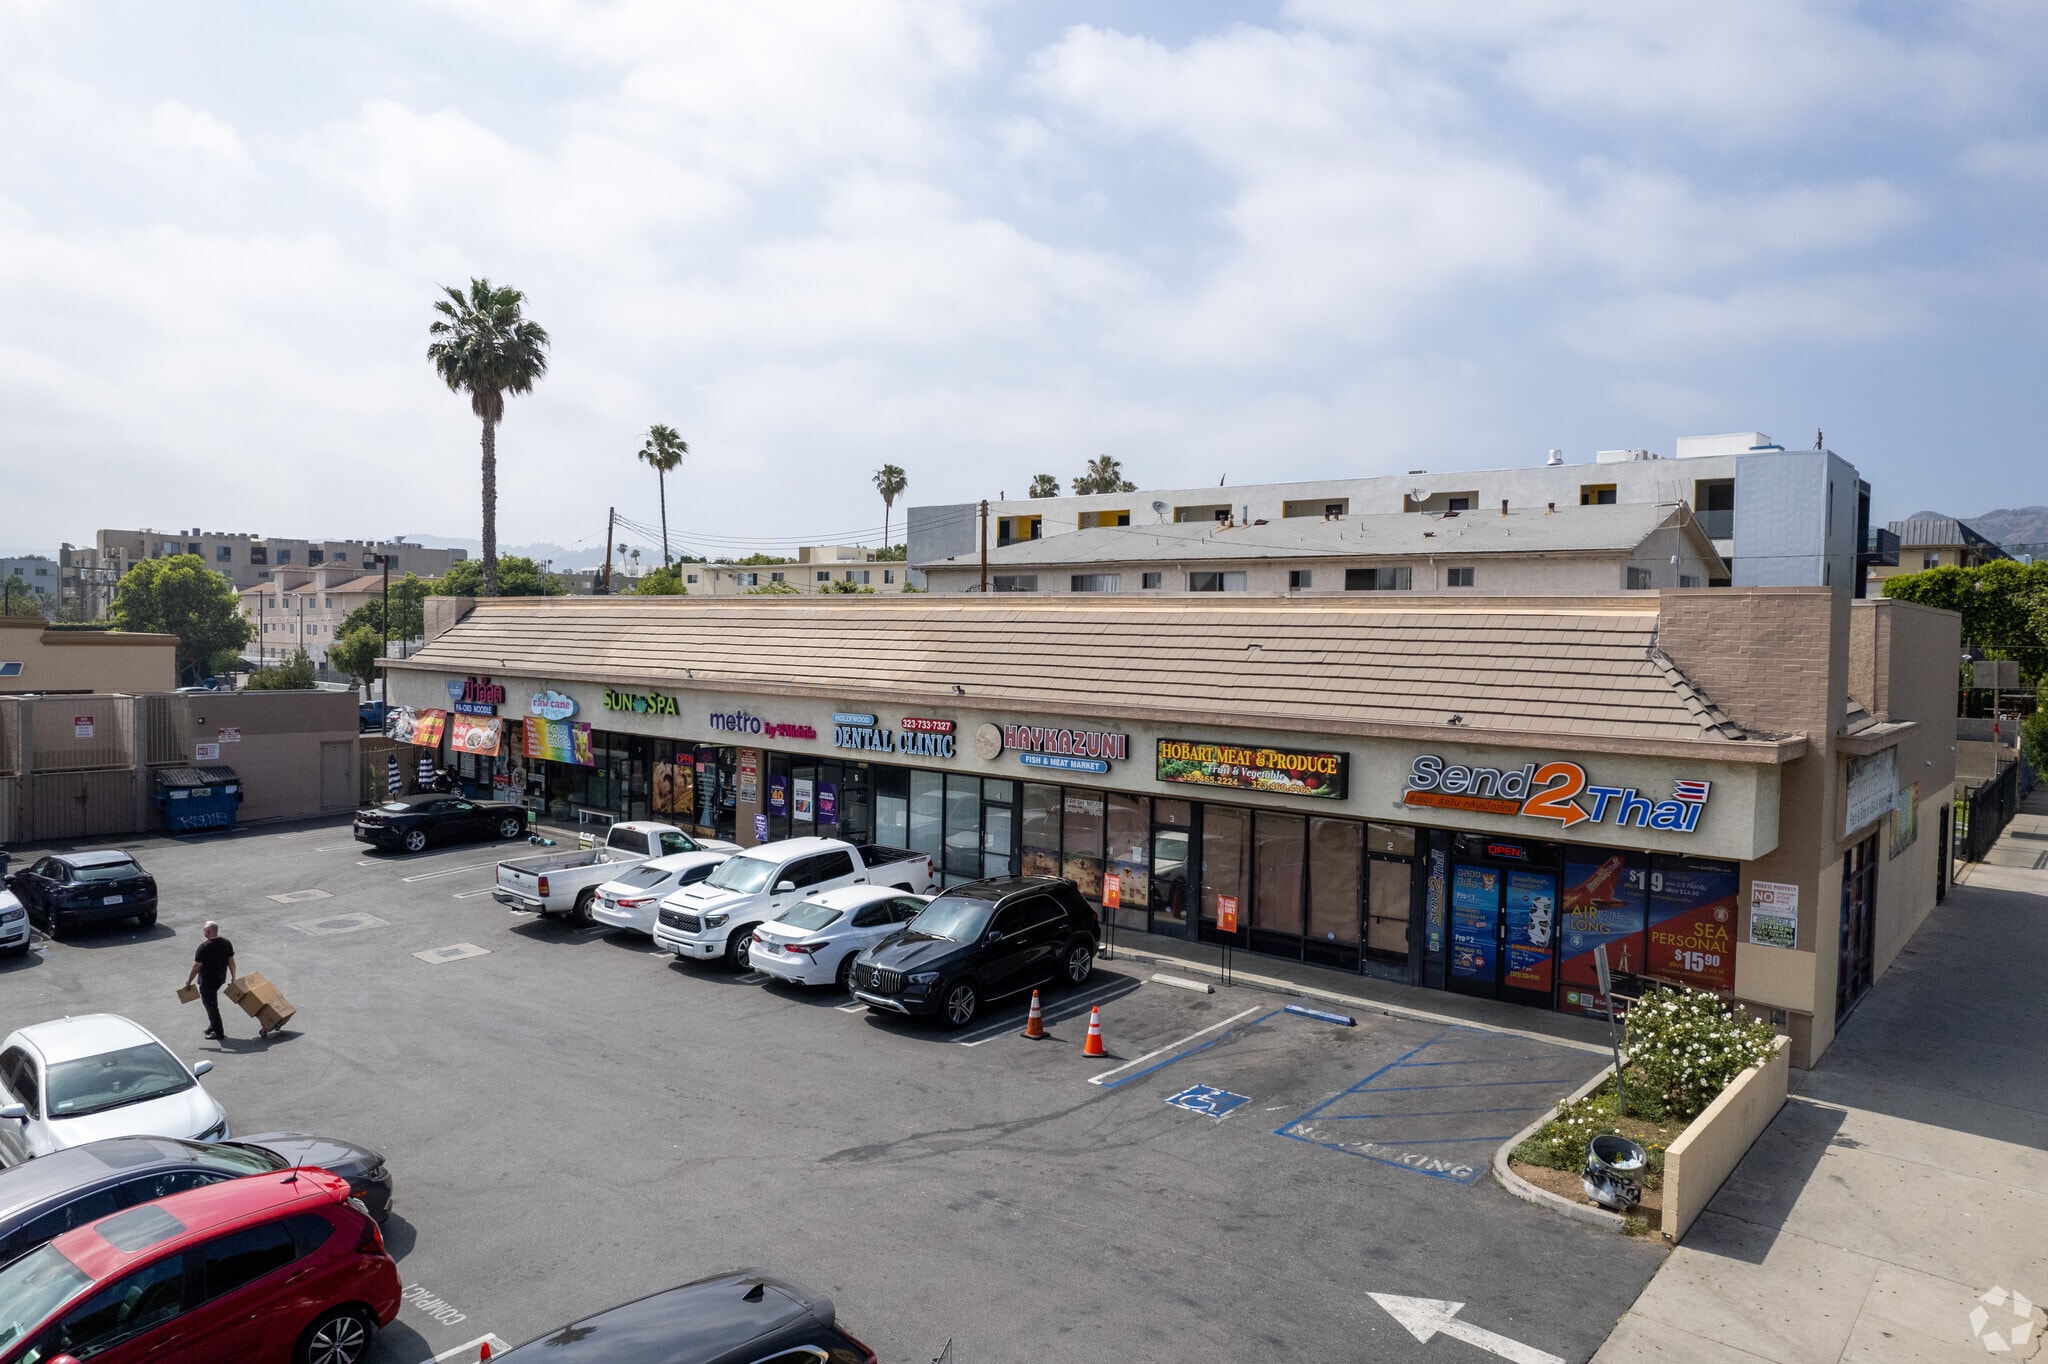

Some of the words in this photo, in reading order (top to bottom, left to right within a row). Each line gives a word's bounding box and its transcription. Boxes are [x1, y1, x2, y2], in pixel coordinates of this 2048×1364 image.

[474, 706, 492, 714] NOODLE
[533, 699, 548, 708] raw
[550, 700, 570, 710] cane
[602, 688, 632, 712] SUN
[647, 692, 676, 716] SPA
[710, 711, 761, 734] metro
[835, 714, 870, 724] HOLLYWOOD
[832, 726, 893, 752] DENTAL
[898, 731, 954, 758] CLINIC
[1004, 724, 1126, 760] HAYKAZUNI
[1025, 756, 1041, 764] FISH
[1042, 756, 1048, 765] &
[1050, 758, 1068, 767] MEAT
[1070, 760, 1100, 770] MARKET
[1162, 743, 1214, 762] HOBART
[1216, 748, 1251, 766] MEAT
[1256, 752, 1266, 767] &
[1268, 752, 1337, 774] PRODUCE
[1208, 764, 1231, 775] Fruit
[1232, 766, 1239, 776] &
[1241, 768, 1286, 780] Vegetable
[1182, 773, 1239, 786] 323.465.2224
[1251, 780, 1312, 794] 323.460.4462
[1066, 798, 1084, 806] FRESH
[1086, 800, 1102, 808] MEAT
[1488, 845, 1521, 857] OPEN
[1754, 891, 1774, 902] NO
[1571, 904, 1598, 920] AIR
[1570, 920, 1610, 934] LONG
[1694, 922, 1728, 940] SEA
[1652, 932, 1728, 954] PERSONAL
